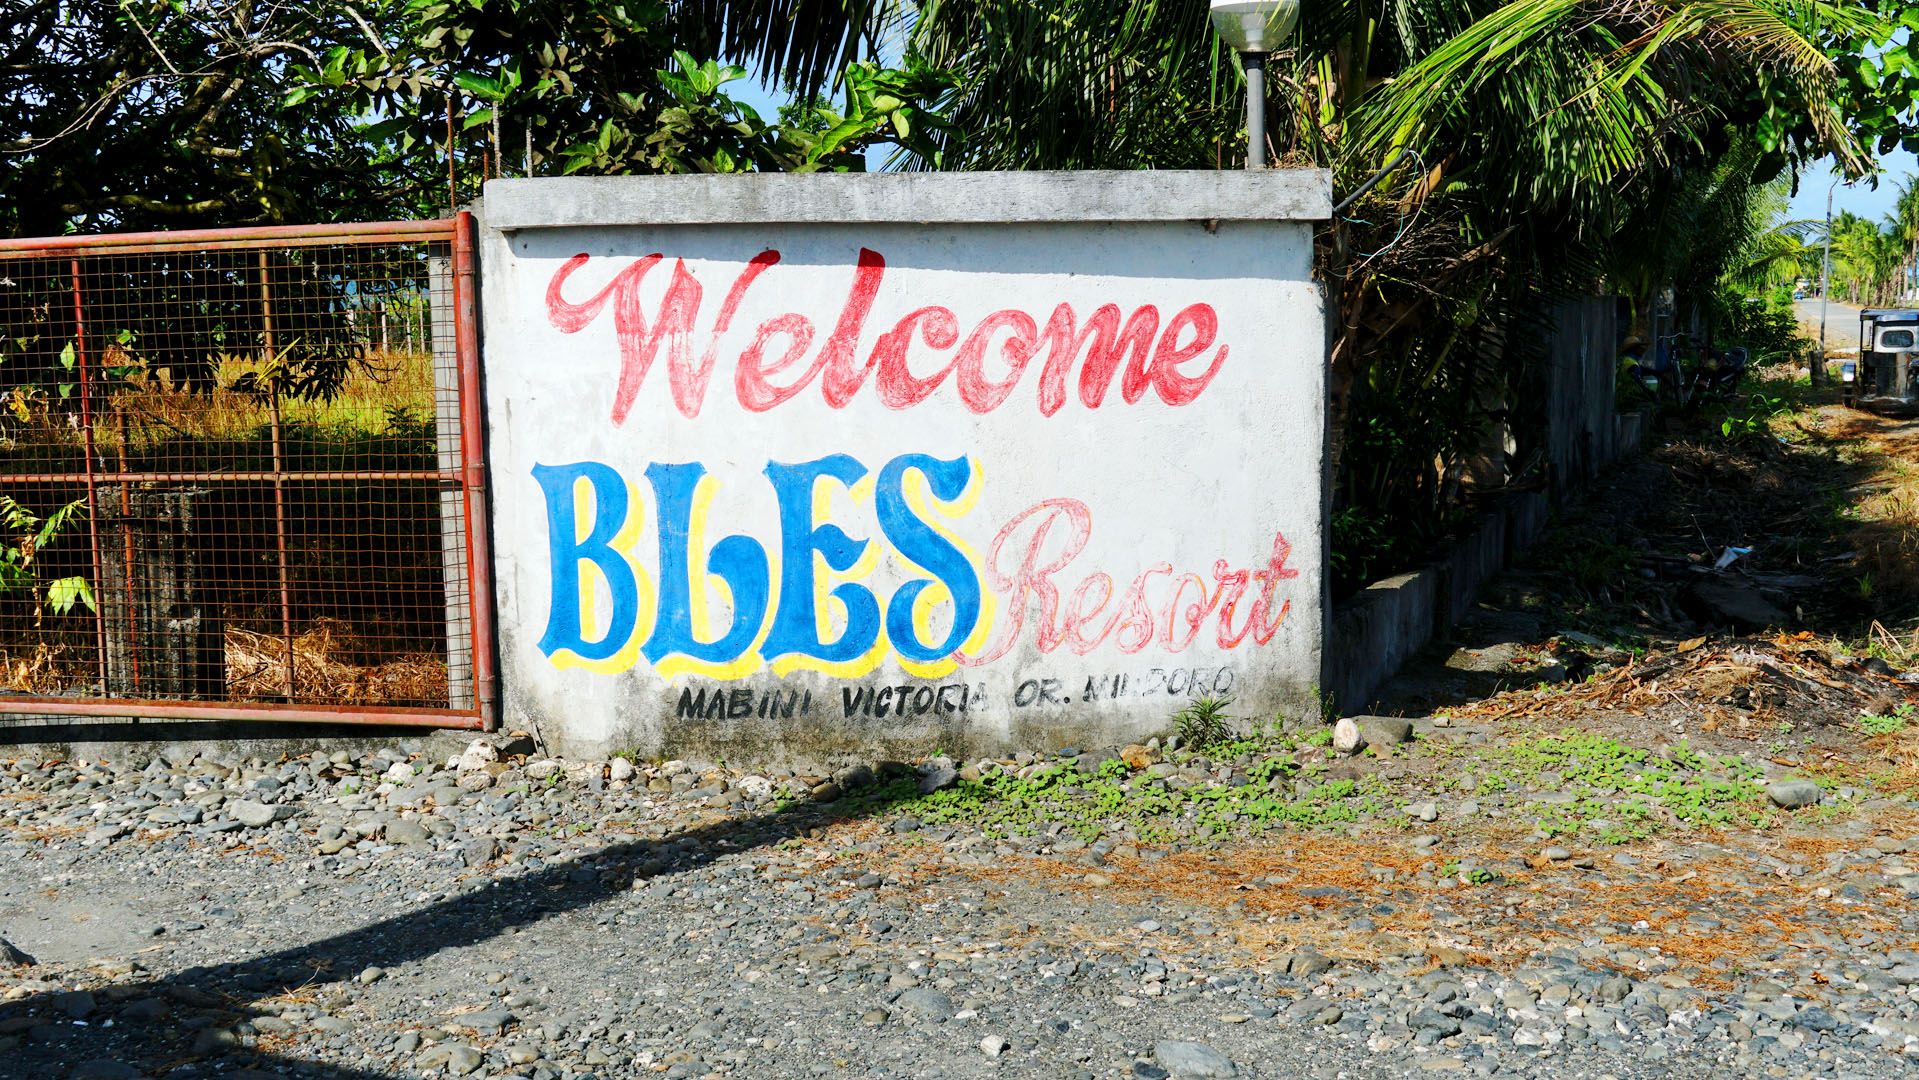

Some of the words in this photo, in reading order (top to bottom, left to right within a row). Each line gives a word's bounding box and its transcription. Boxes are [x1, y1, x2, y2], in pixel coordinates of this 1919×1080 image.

[545, 247, 1230, 427] Welcome
[532, 453, 996, 681] BLES
[951, 497, 1299, 667] Resort
[676, 686, 812, 721] MABINI
[841, 682, 988, 719] VICTORIA
[1014, 677, 1071, 707] OR.
